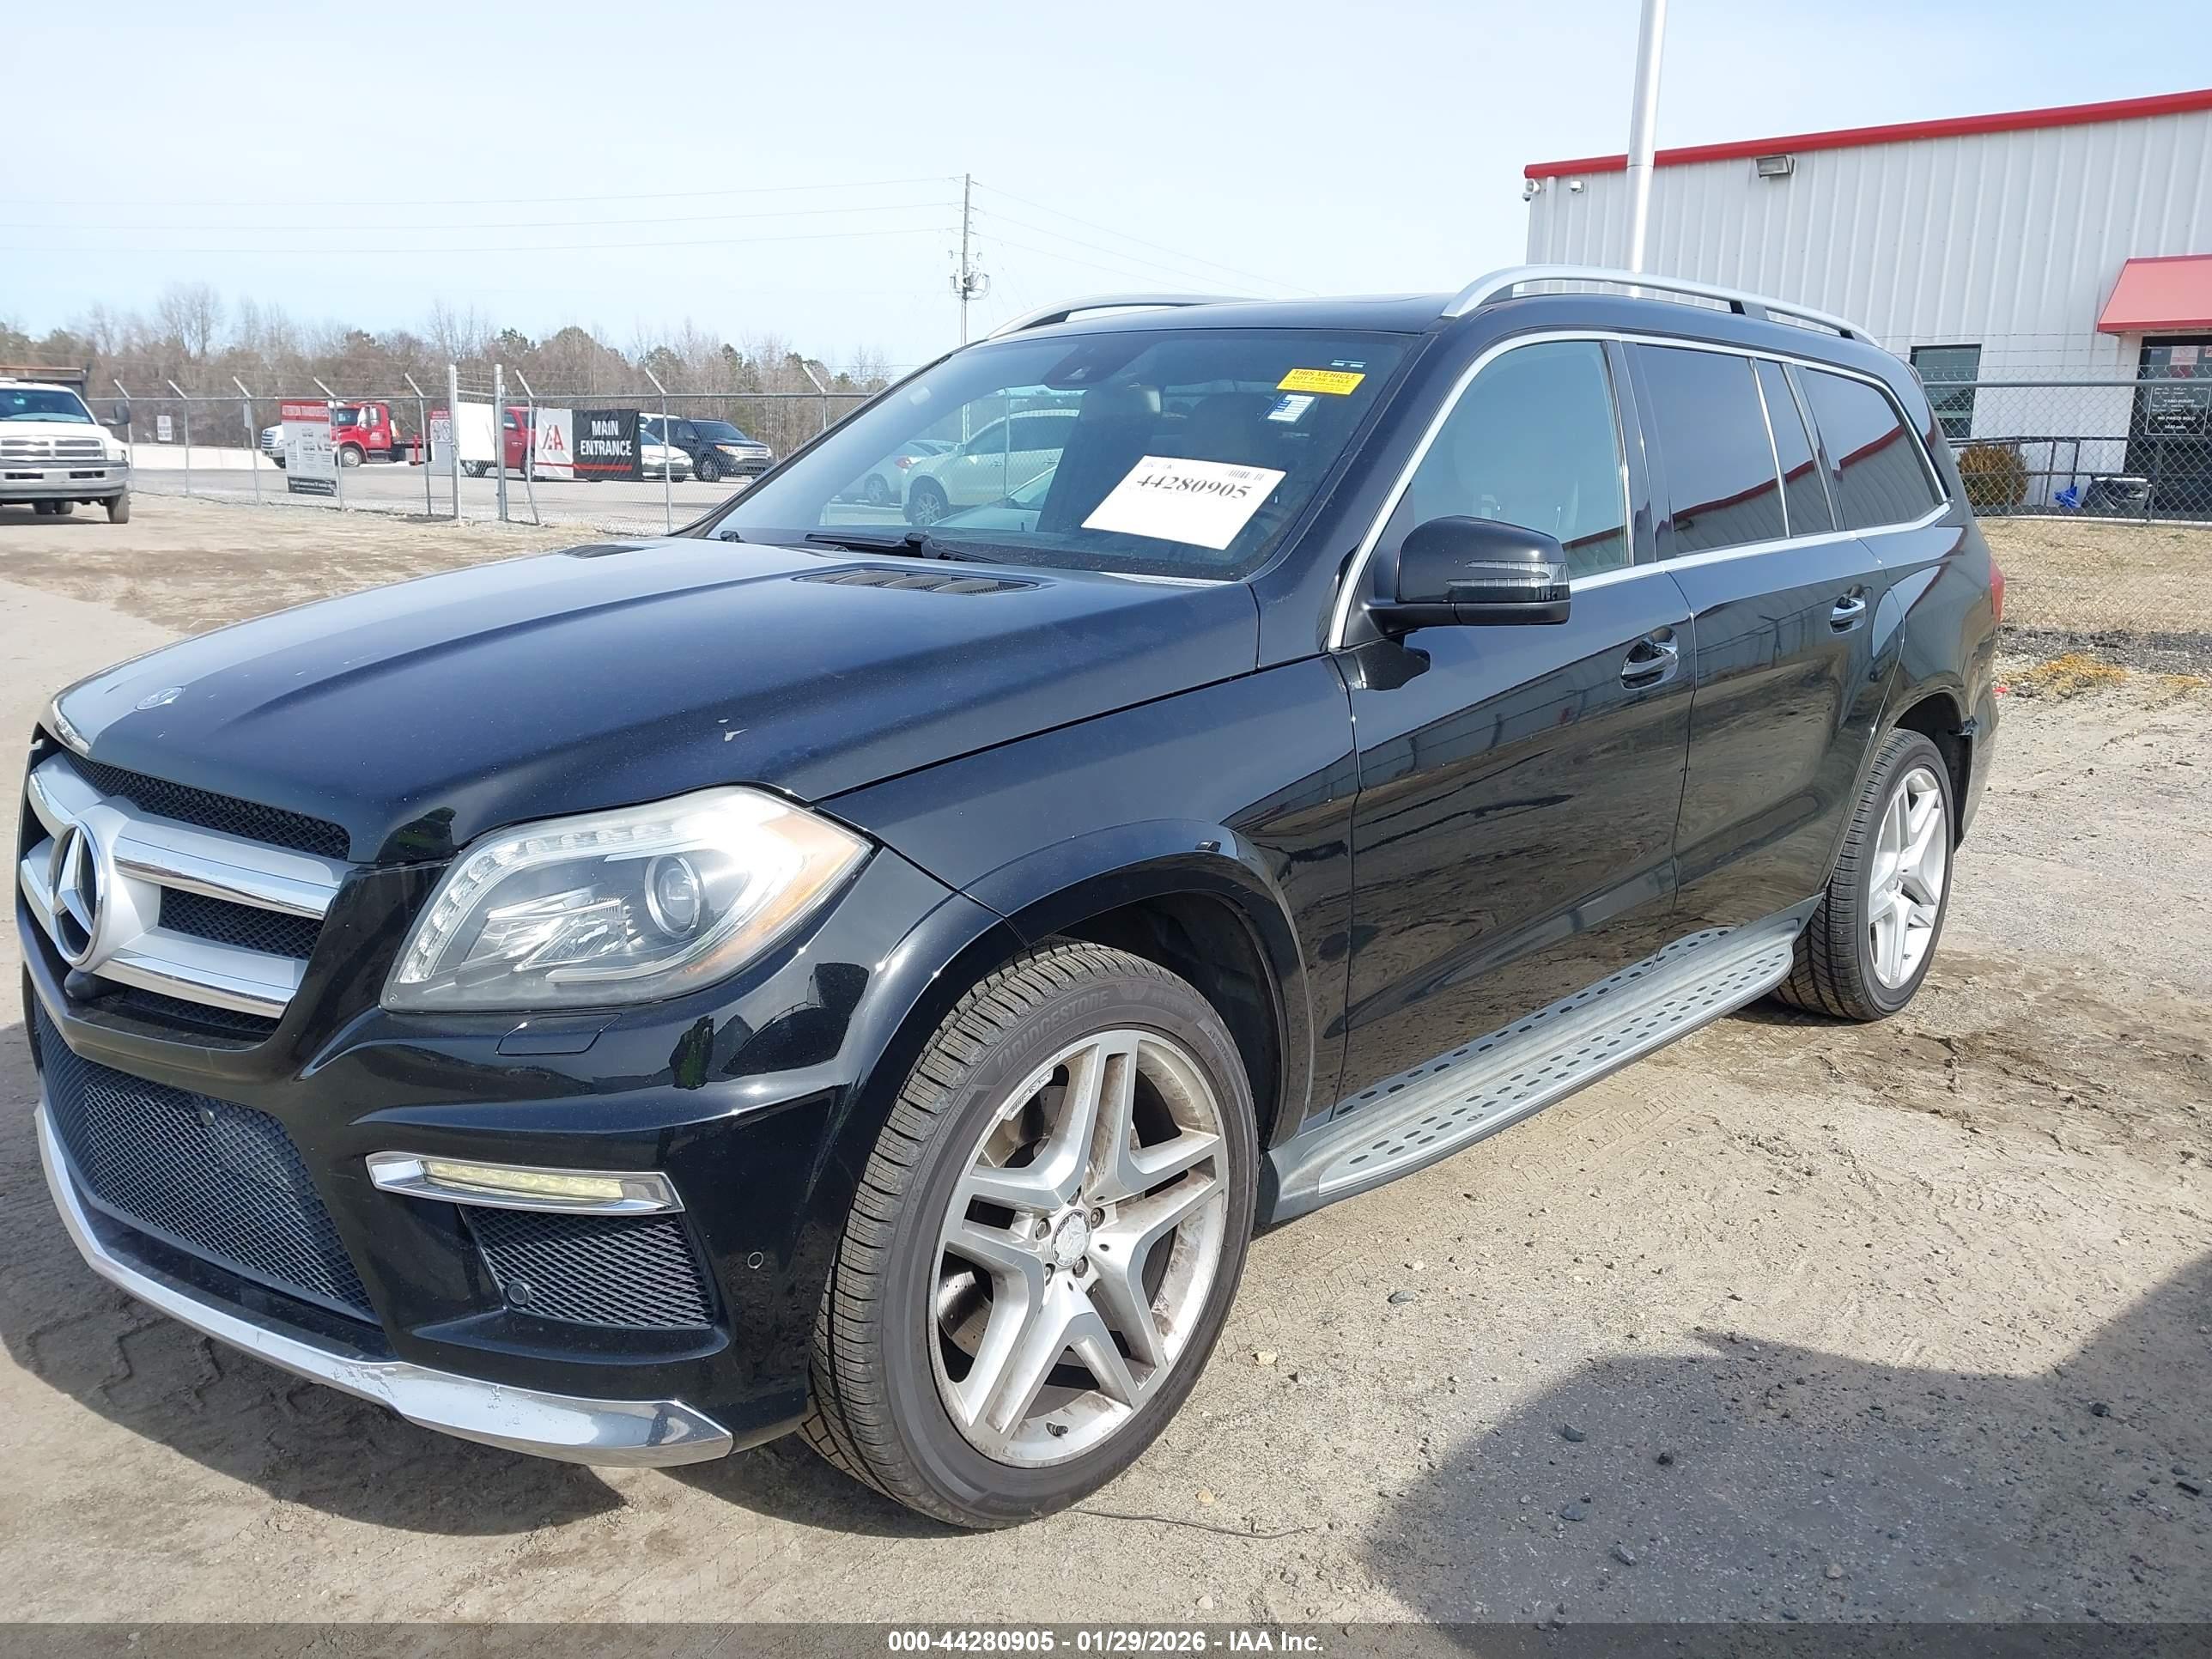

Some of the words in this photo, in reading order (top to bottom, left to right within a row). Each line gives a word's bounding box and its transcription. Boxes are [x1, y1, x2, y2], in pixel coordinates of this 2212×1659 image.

[591, 420, 619, 436] MAIN
[580, 440, 633, 456] ENTRANCE
[1137, 473, 1253, 500] 44280905
[997, 989, 1110, 1069] BRIDGESTONE
